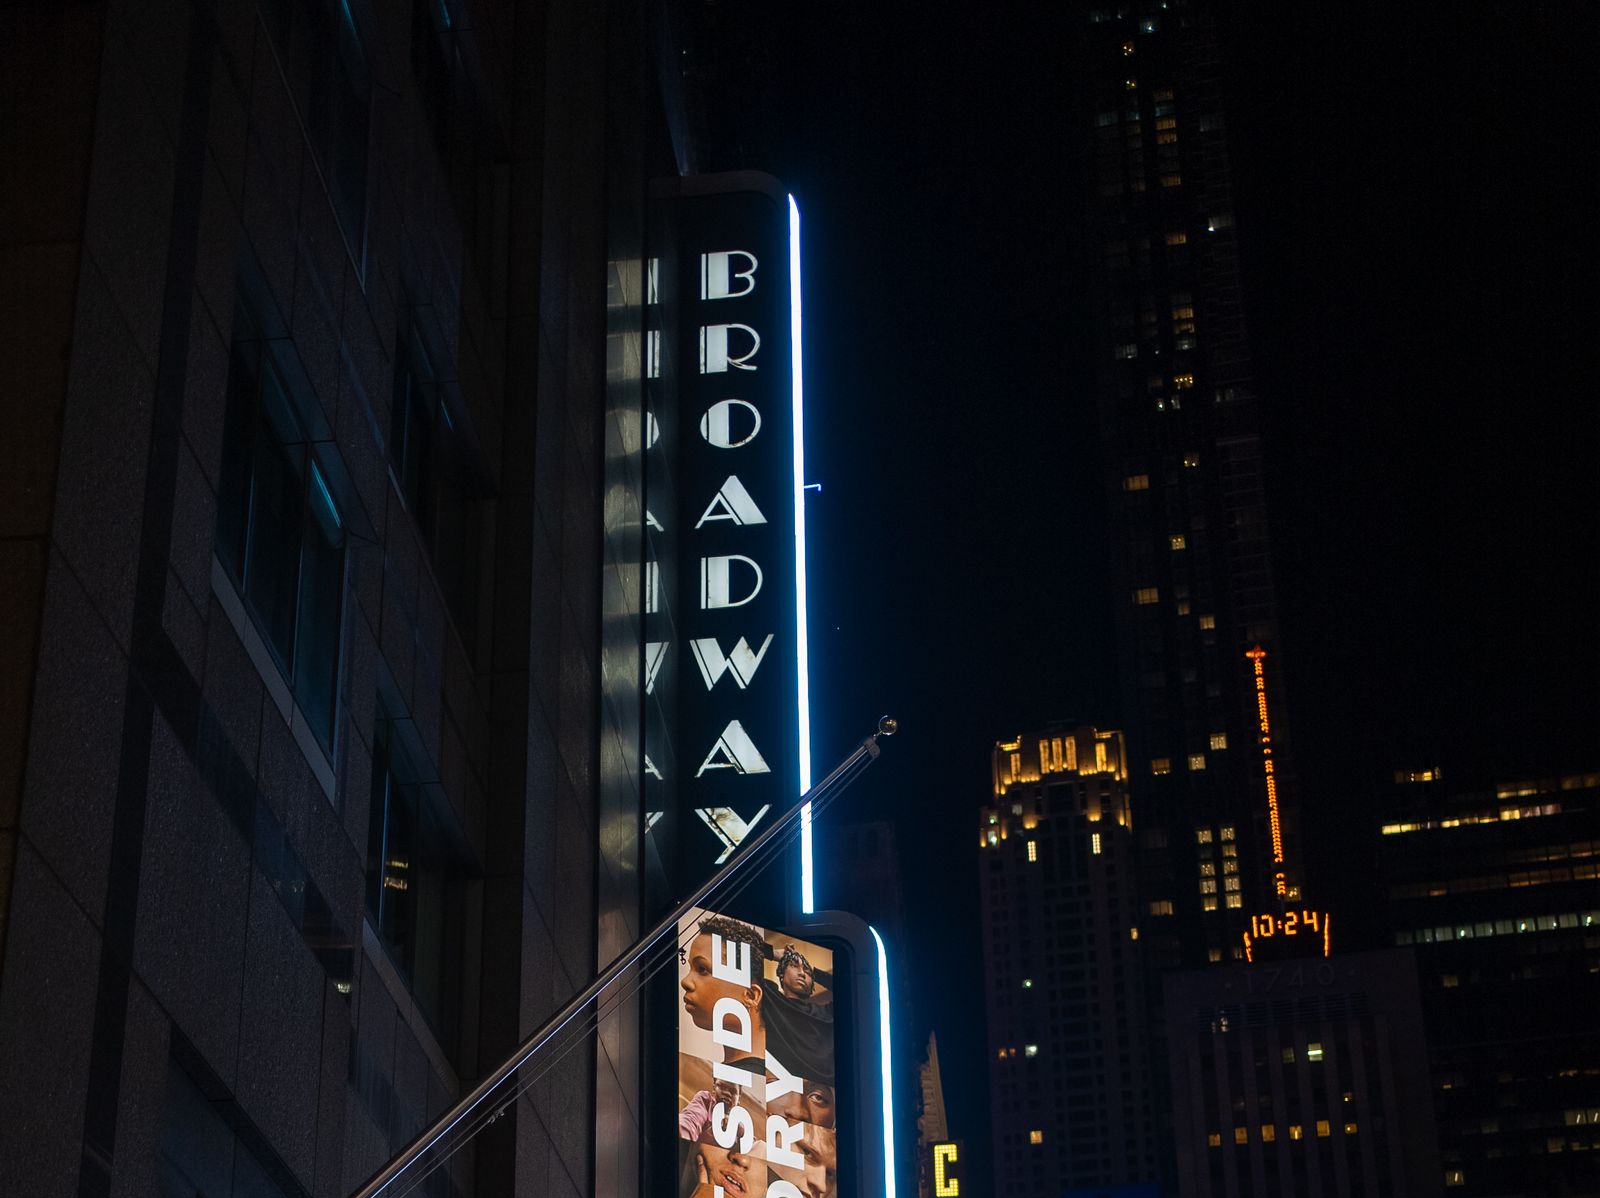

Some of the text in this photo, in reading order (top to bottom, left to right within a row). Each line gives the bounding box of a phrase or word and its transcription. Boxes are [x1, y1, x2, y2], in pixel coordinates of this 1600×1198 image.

[689, 249, 775, 866] BROADWAY
[1252, 909, 1319, 938] 10:24
[711, 932, 754, 1156] SIDE
